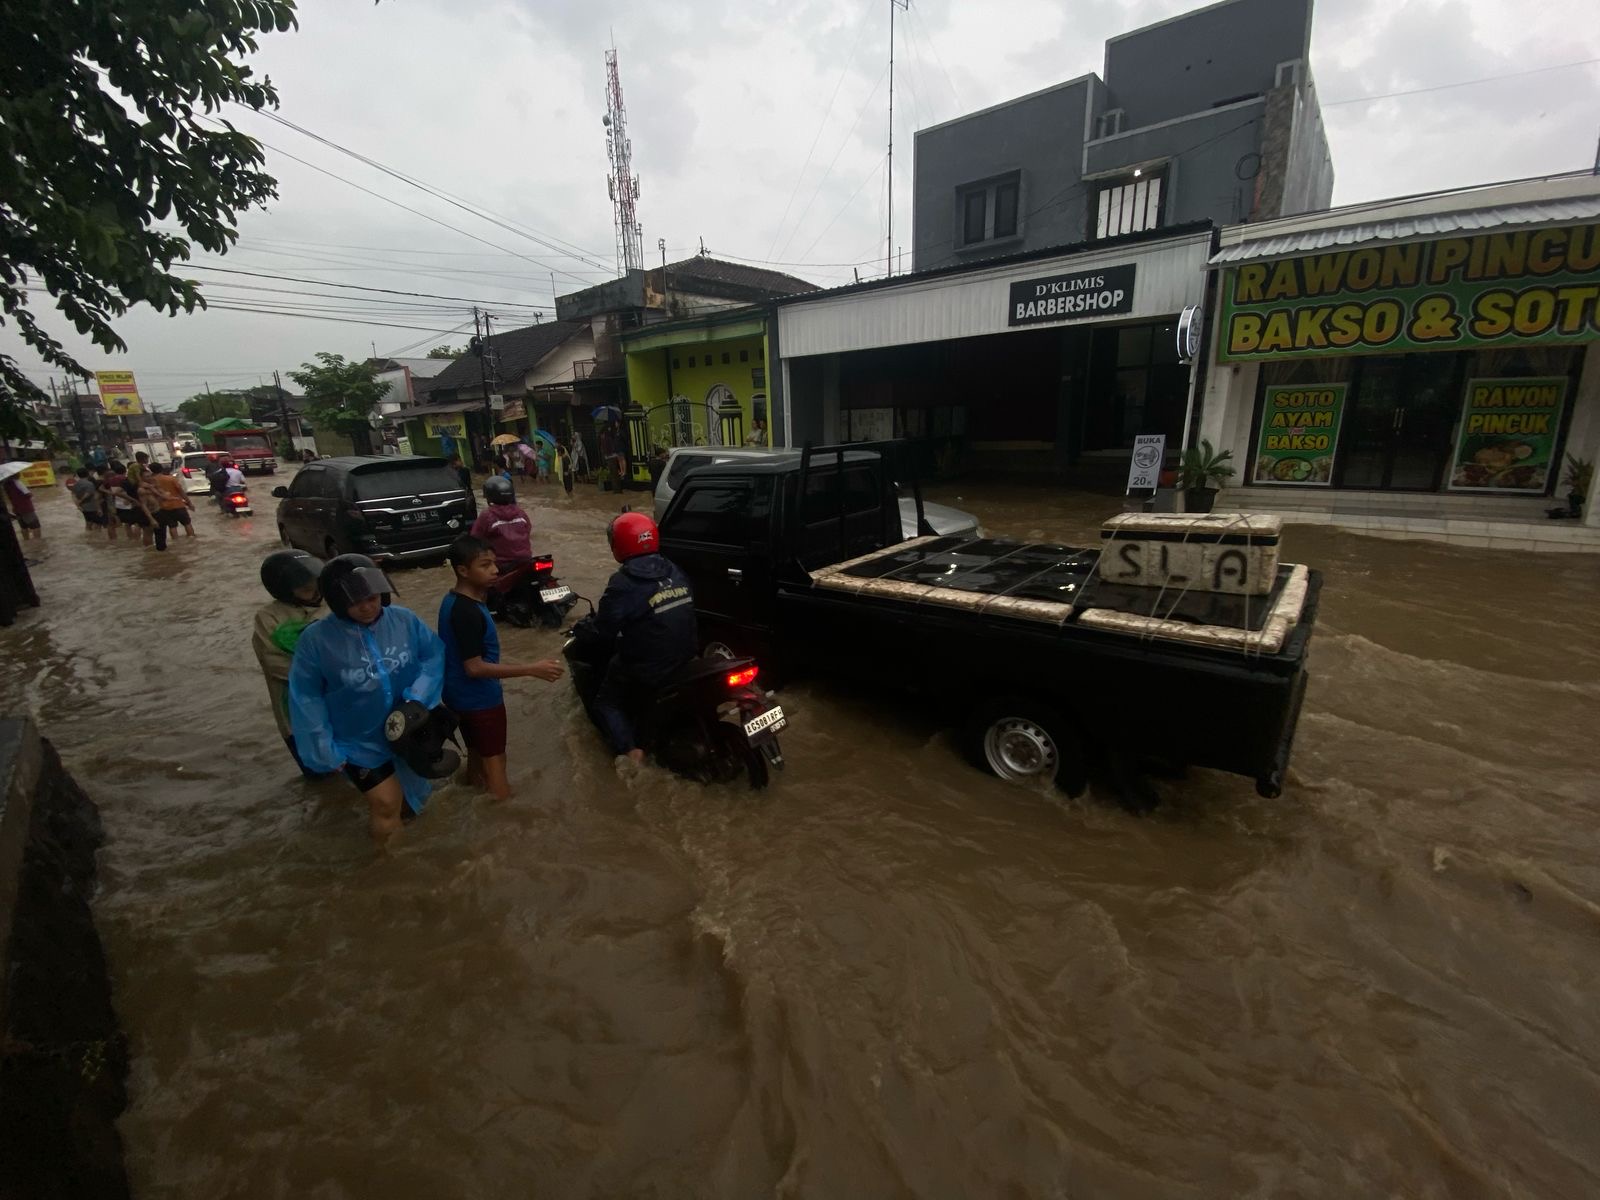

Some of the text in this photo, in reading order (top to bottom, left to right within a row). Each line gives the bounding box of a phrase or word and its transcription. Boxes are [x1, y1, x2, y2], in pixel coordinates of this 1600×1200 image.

[1237, 244, 1421, 302] RAWON
[1036, 275, 1105, 296] D'KLIMIS
[1016, 289, 1123, 319] BARBERSHOP
[1232, 304, 1399, 352] BAKSO
[1413, 296, 1458, 340] &
[1473, 287, 1600, 336] SOT
[1274, 390, 1336, 408] SOTO
[1471, 385, 1557, 408] RAWON
[1270, 411, 1334, 428] AYAM
[1467, 412, 1552, 434] PINCUK
[1266, 434, 1329, 451] BAKSO
[1132, 476, 1146, 486] 20
